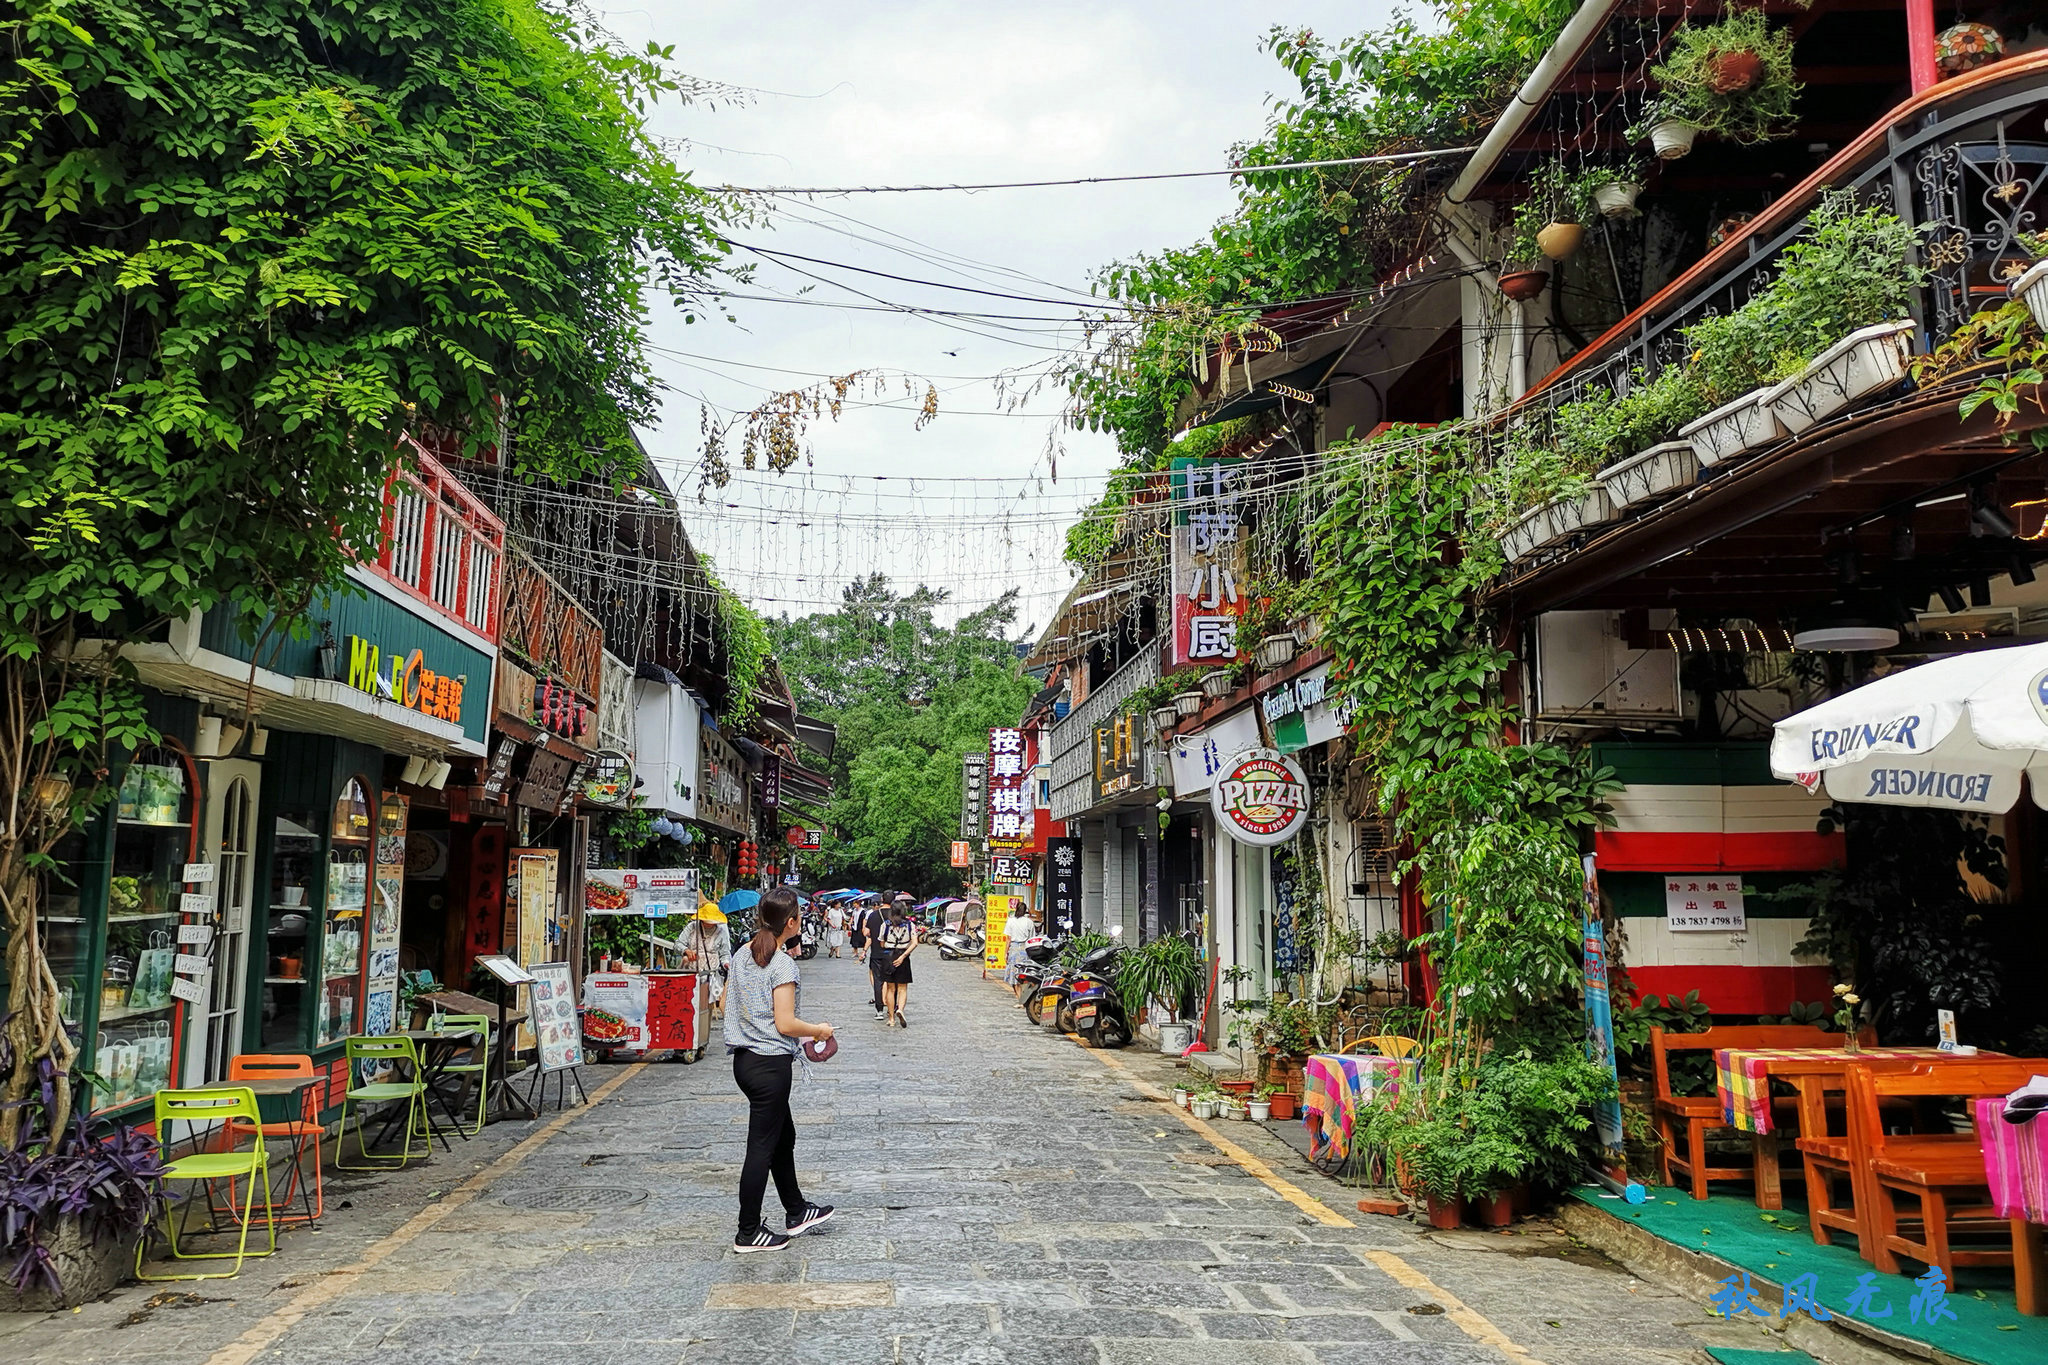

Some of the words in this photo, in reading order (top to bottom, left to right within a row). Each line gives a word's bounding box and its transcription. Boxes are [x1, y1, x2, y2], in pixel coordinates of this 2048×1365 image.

[1187, 462, 1239, 659] 比萨小厨
[1811, 715, 1921, 762] ERDINGER
[1239, 761, 1288, 778] woodfired
[966, 765, 981, 838] 娜娜咖啡旅馆
[1220, 780, 1307, 812] PIZZA
[1239, 818, 1264, 833] since
[1267, 817, 1288, 832] 1999
[989, 840, 1022, 848] Massage
[995, 859, 1032, 878] 足浴
[994, 876, 1033, 885] Massage
[1685, 900, 1727, 910] 出租
[1672, 917, 1686, 926] 138
[1688, 917, 1708, 926] 7837
[1710, 917, 1731, 926] 4798
